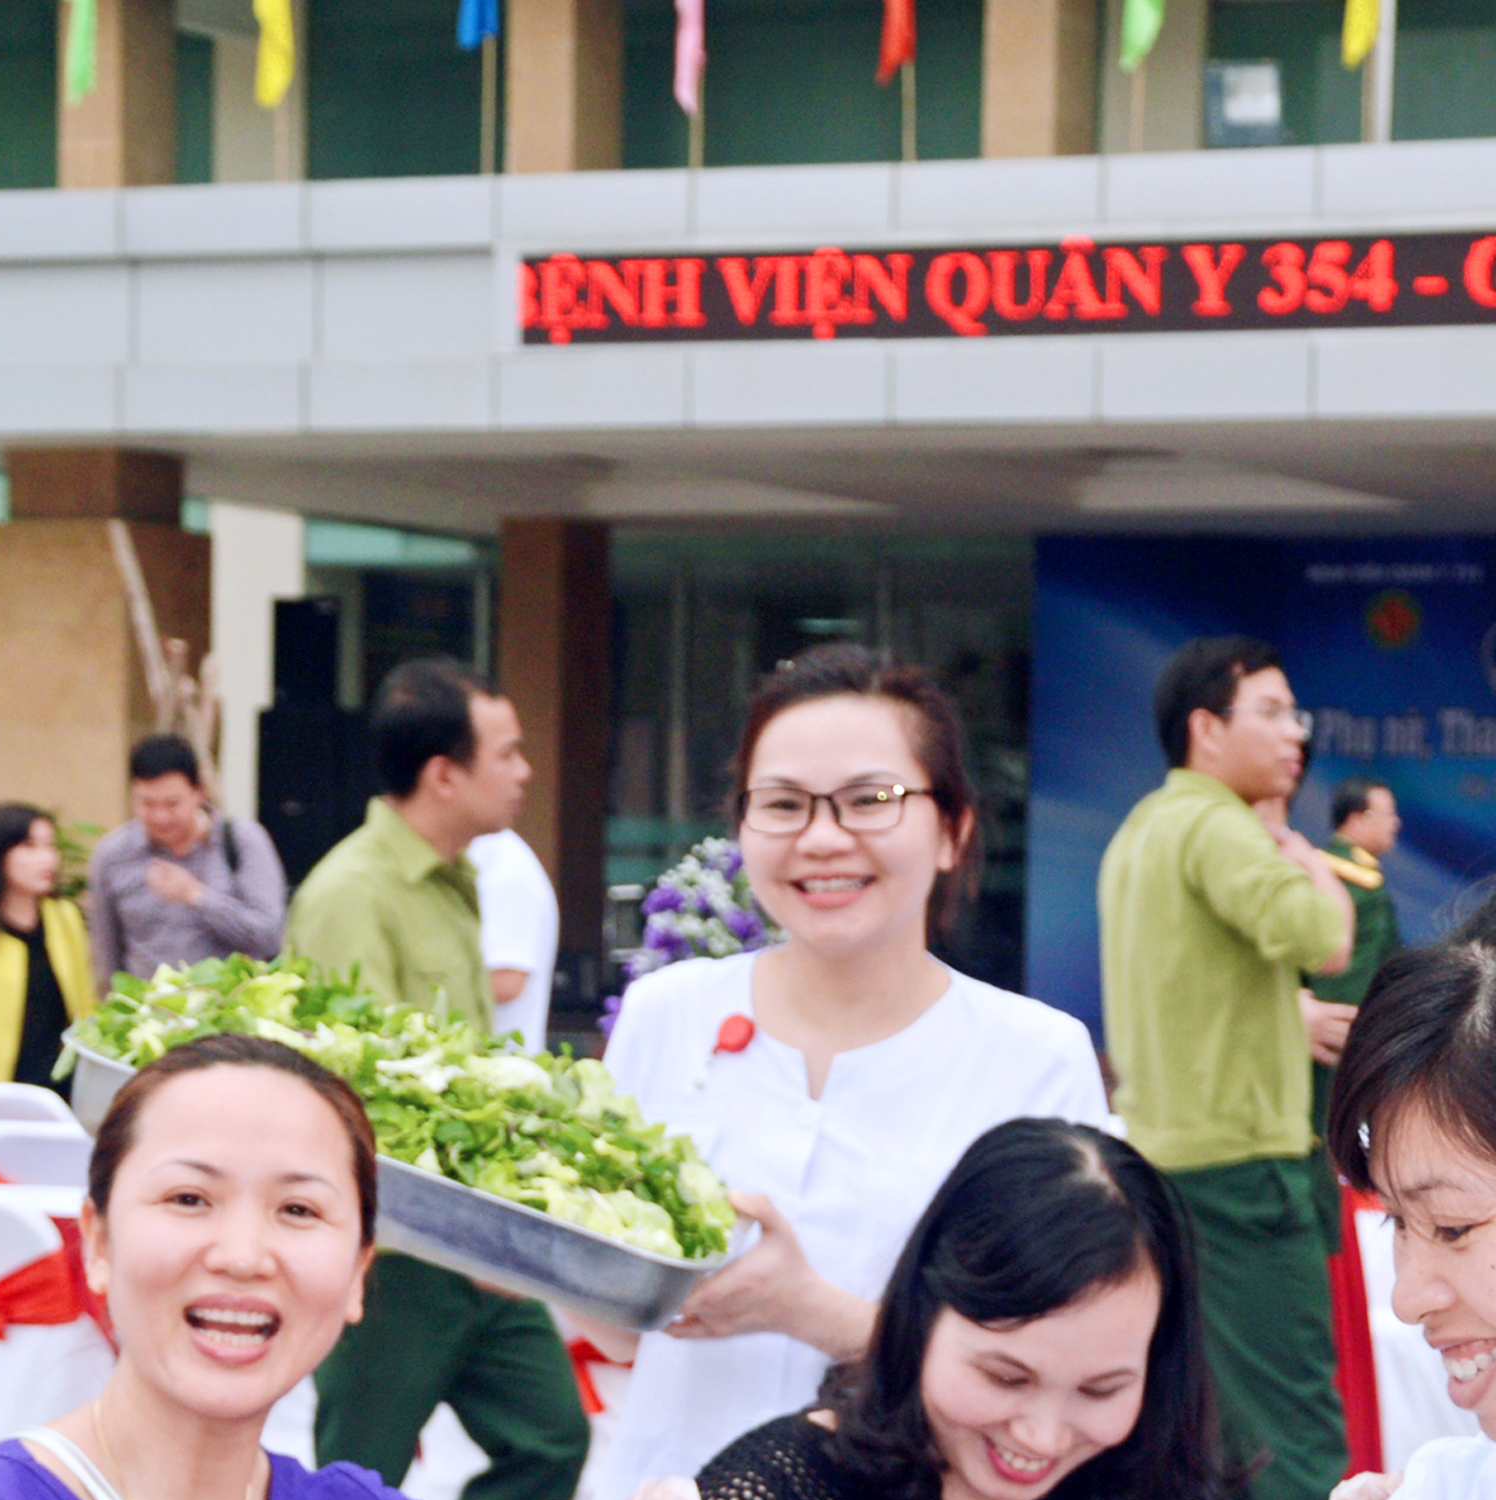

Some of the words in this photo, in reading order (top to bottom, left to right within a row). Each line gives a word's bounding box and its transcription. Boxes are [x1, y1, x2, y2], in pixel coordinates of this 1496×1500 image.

[714, 246, 913, 341] VIỆN
[1181, 243, 1246, 317] Y
[1257, 239, 1399, 315] 354
